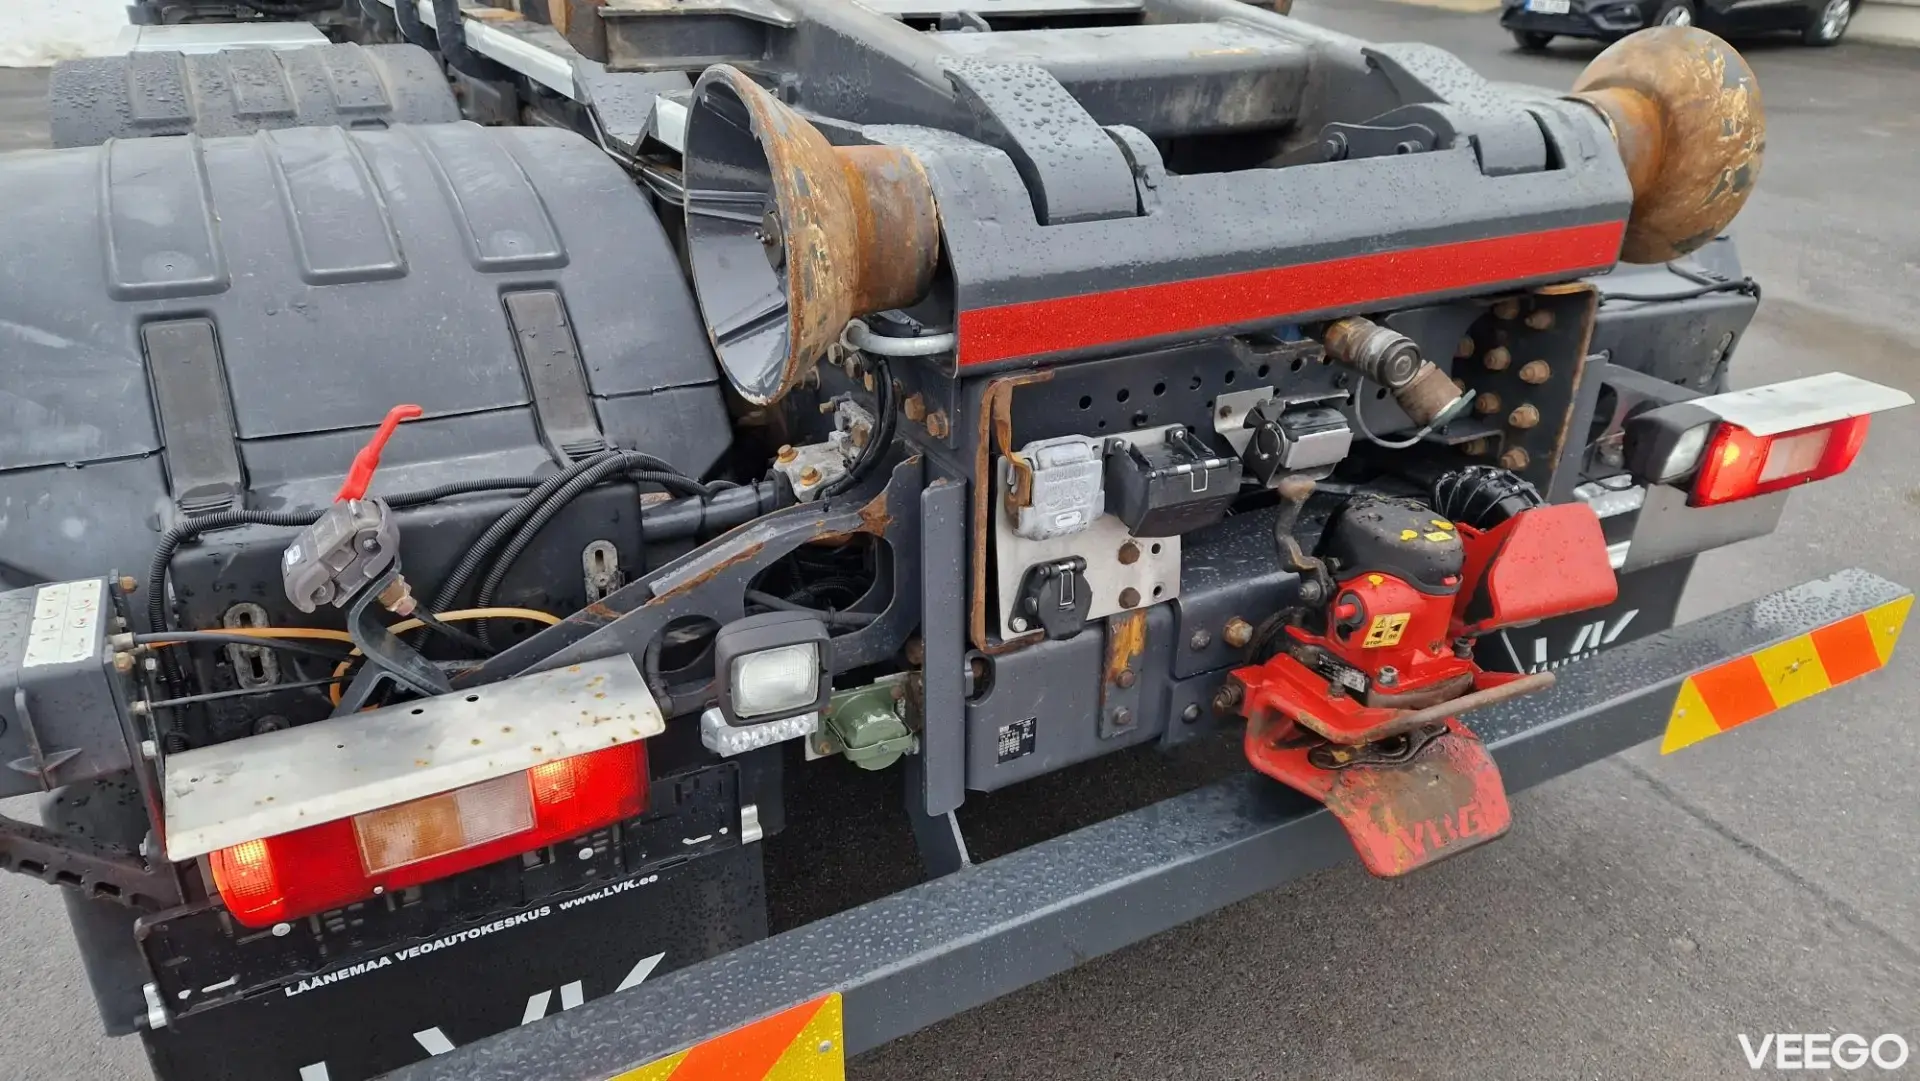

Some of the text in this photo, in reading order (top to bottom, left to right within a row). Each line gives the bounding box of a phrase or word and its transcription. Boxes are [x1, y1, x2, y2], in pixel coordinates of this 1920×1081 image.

[284, 874, 659, 997] LÄÄNEMAA VEOAUTOKESKUS www.LVK.ee
